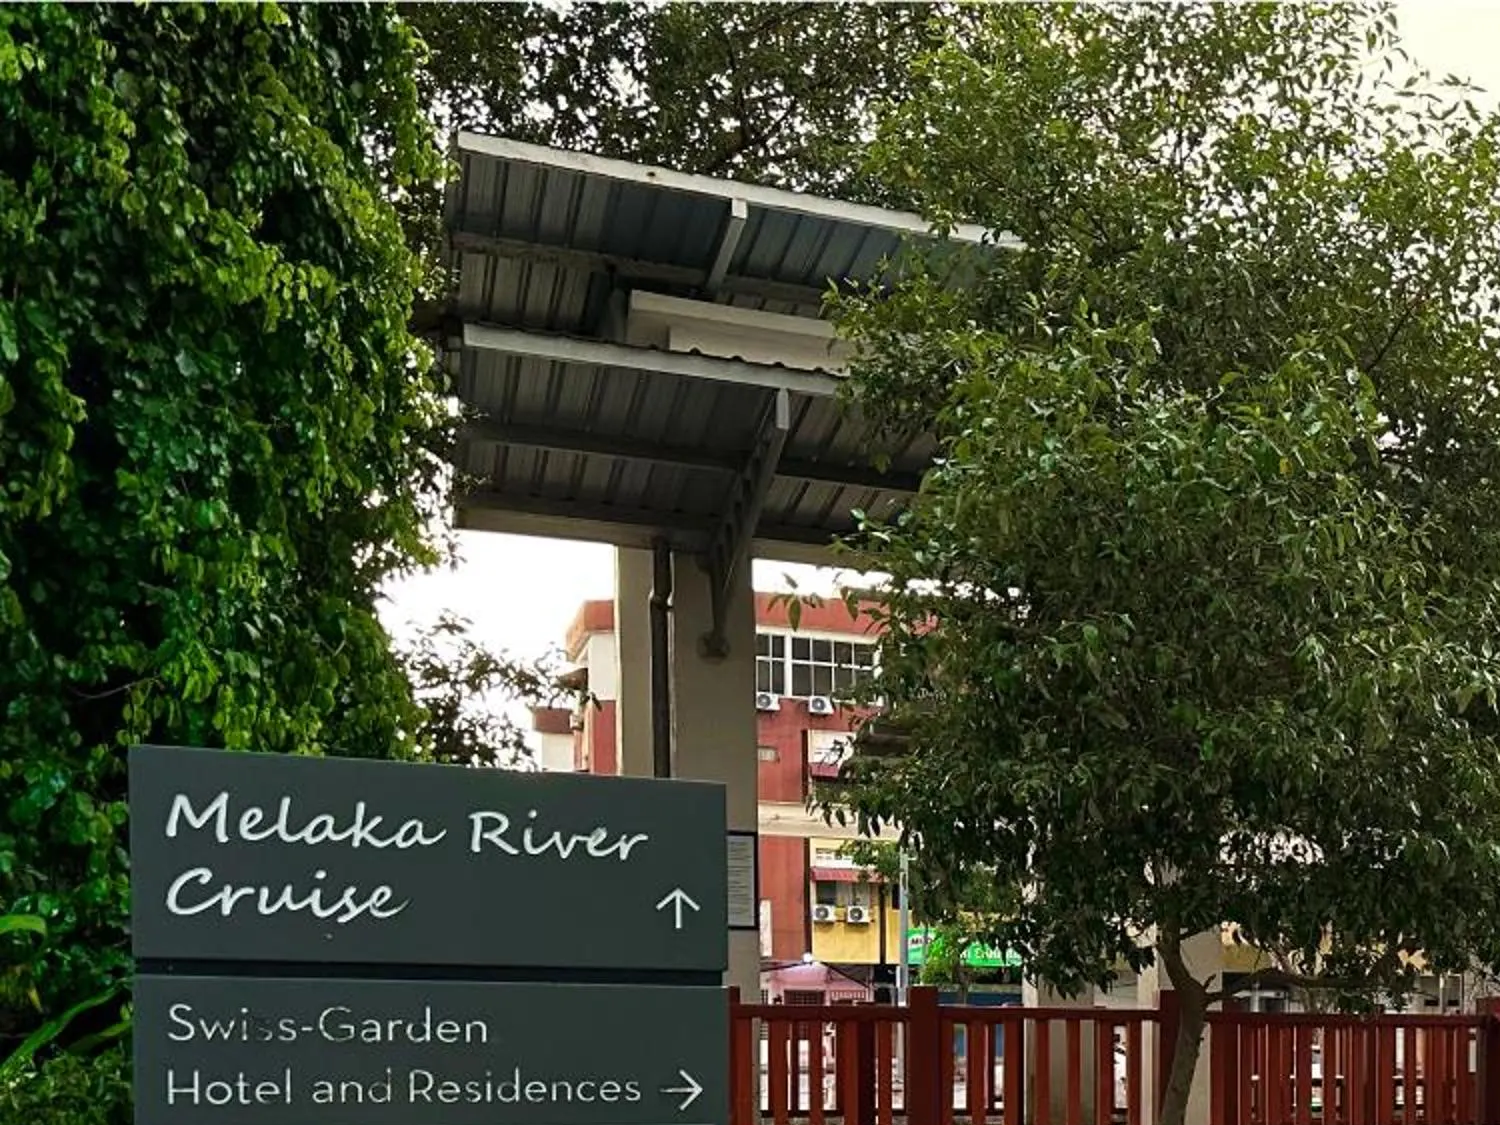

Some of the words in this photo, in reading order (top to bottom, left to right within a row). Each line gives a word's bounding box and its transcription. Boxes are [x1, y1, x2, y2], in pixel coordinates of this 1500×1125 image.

[165, 792, 447, 850] Melaka
[468, 809, 649, 861] River
[165, 866, 410, 923] Cruise
[167, 1066, 292, 1105] Hotel
[312, 1066, 392, 1104] and
[408, 1068, 642, 1104] Residences
